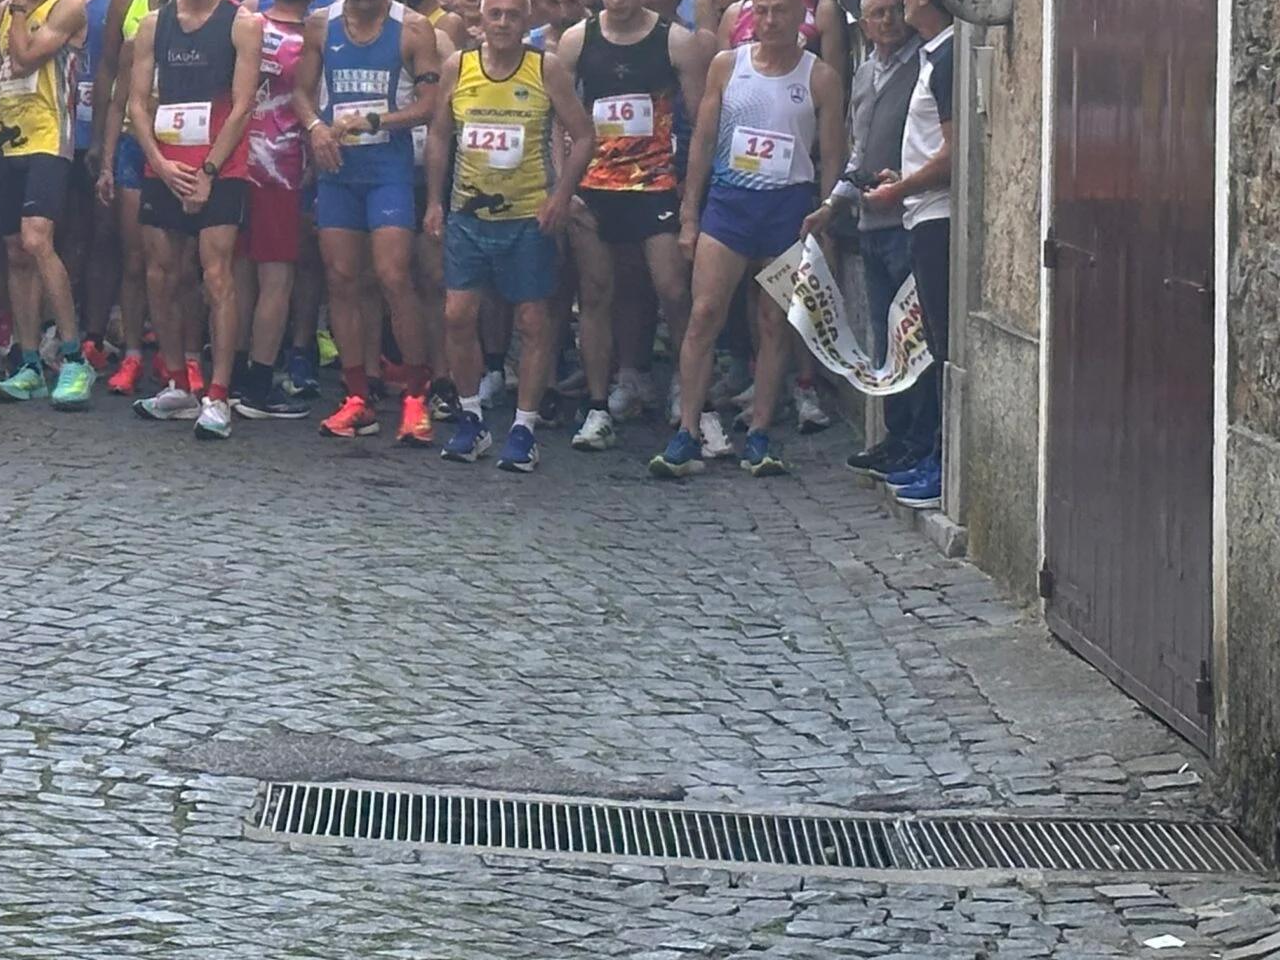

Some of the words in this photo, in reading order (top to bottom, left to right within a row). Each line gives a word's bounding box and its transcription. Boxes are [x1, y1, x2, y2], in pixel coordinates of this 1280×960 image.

[172, 111, 186, 130] 5
[607, 102, 634, 122] 16
[466, 130, 510, 152] 121
[745, 137, 775, 159] 12
